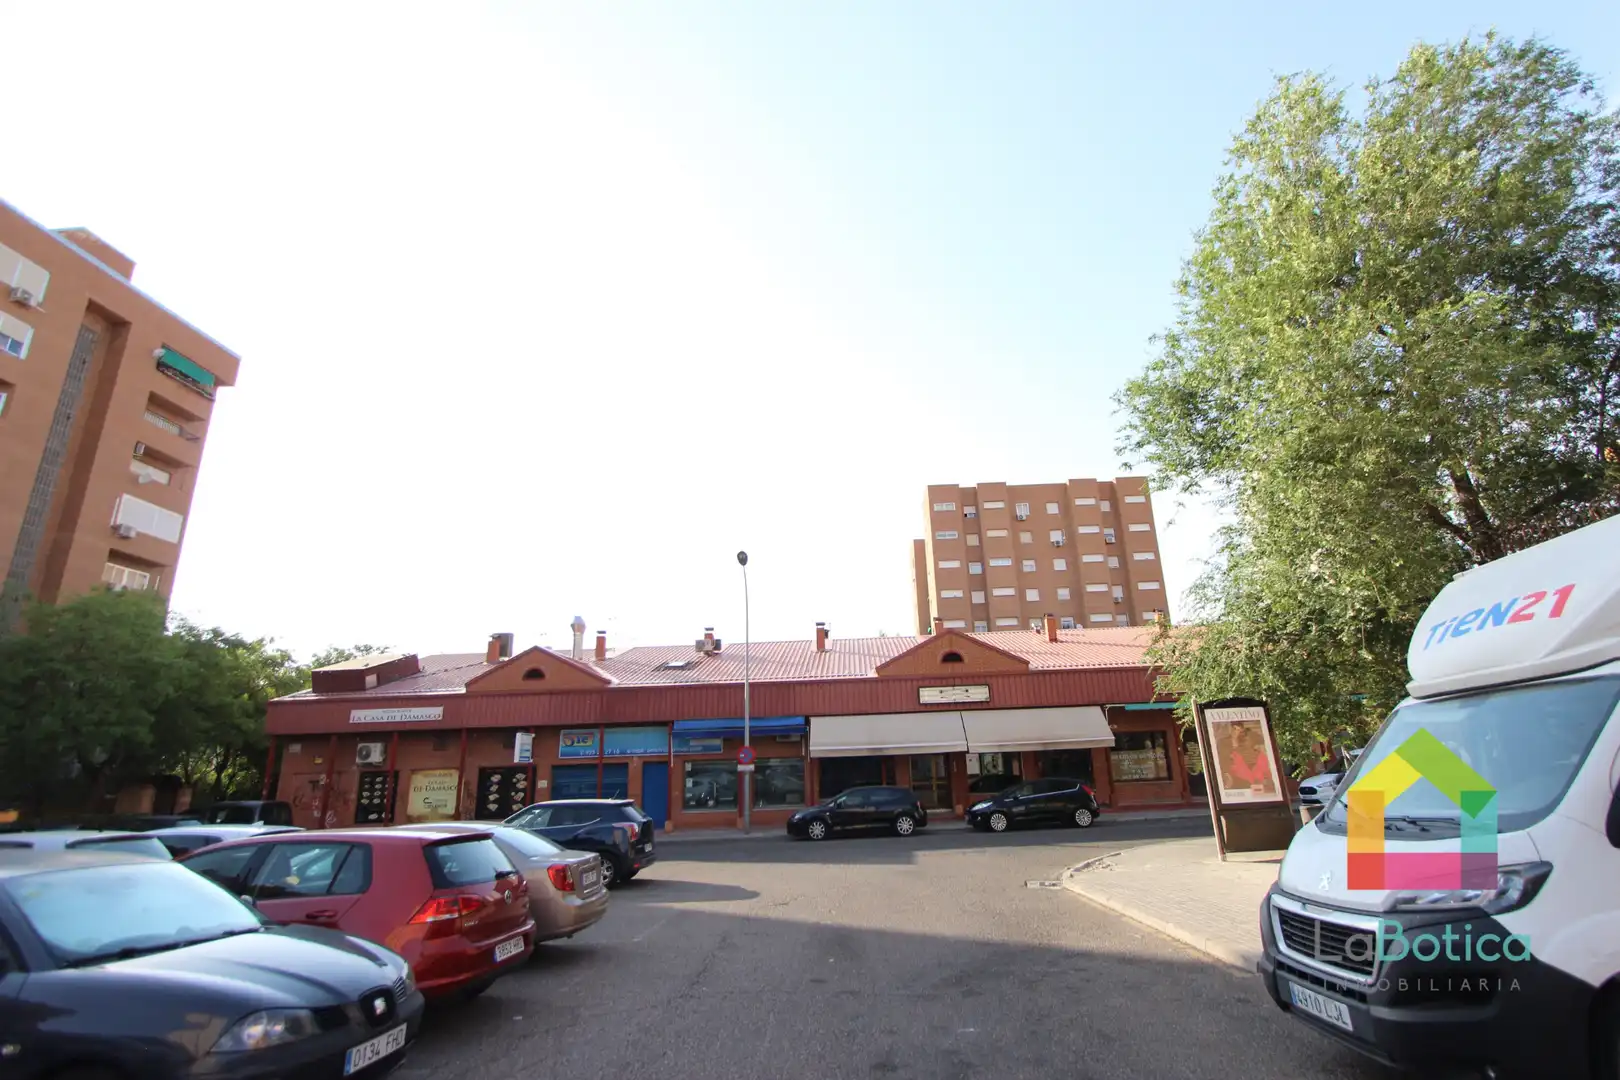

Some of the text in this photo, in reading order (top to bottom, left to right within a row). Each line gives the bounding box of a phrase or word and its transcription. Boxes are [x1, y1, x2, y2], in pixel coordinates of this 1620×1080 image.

[400, 713, 441, 721] DAMASCO
[1209, 709, 1261, 720] VALENTINO
[353, 1040, 381, 1069] 0134
